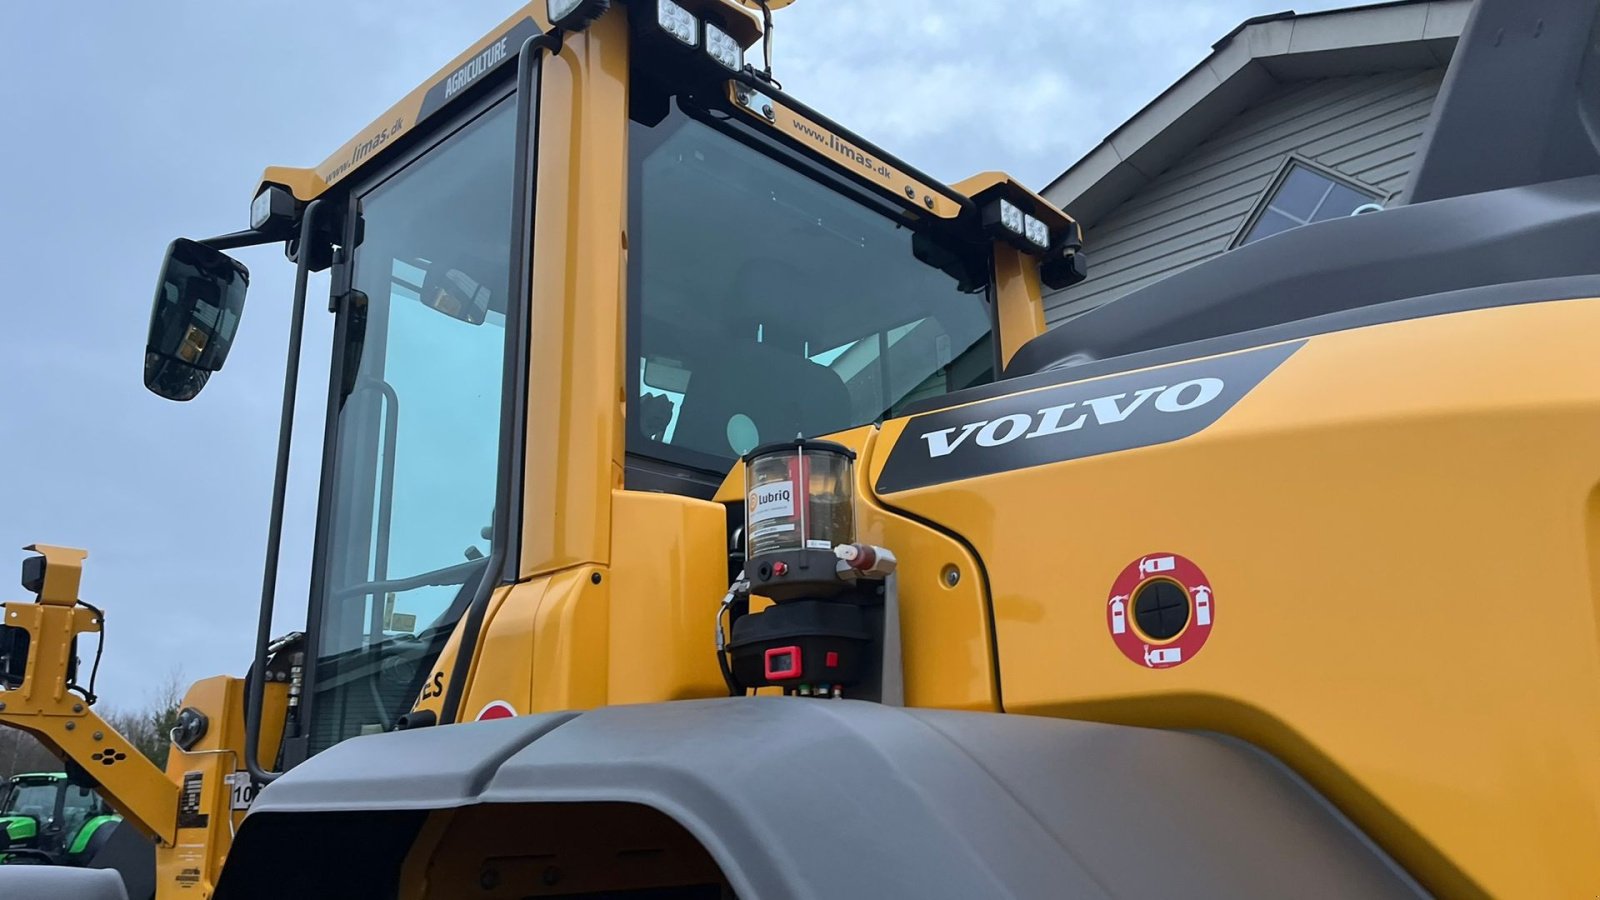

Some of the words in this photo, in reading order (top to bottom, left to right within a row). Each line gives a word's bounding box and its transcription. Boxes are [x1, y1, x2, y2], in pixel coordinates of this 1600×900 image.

[445, 37, 507, 99] AGRICULTURE
[325, 117, 404, 184] www.limas.dk
[793, 119, 891, 179] www.limas.dk
[920, 377, 1225, 458] VOLVO
[758, 490, 790, 505] LubriQ
